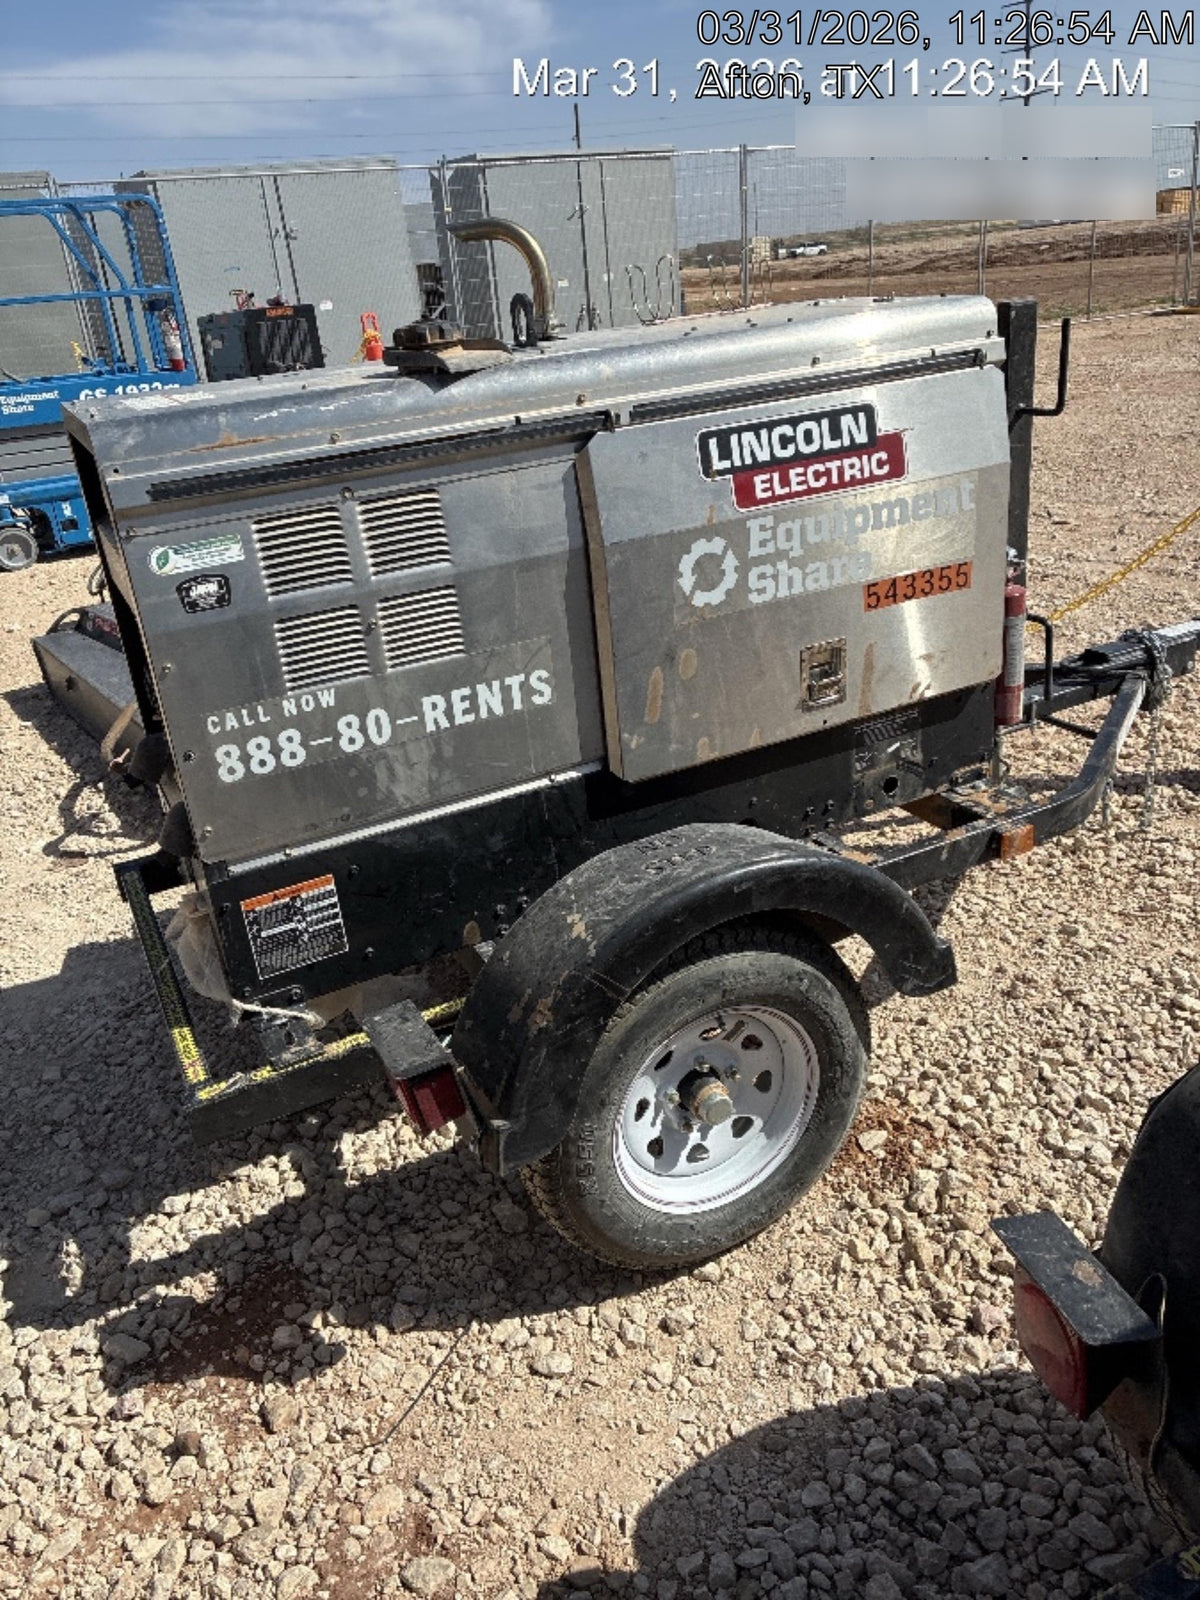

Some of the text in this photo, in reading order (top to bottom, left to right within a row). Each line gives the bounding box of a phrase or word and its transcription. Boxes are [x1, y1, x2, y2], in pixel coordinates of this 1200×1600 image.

[708, 411, 869, 471] LINCOLN
[753, 451, 889, 500] ELECTRIC
[746, 477, 976, 558] Equipment
[747, 551, 874, 604] Share
[866, 562, 970, 610] 543355
[206, 688, 337, 735] CALL NOW
[214, 669, 553, 784] 888-80-RENTS
